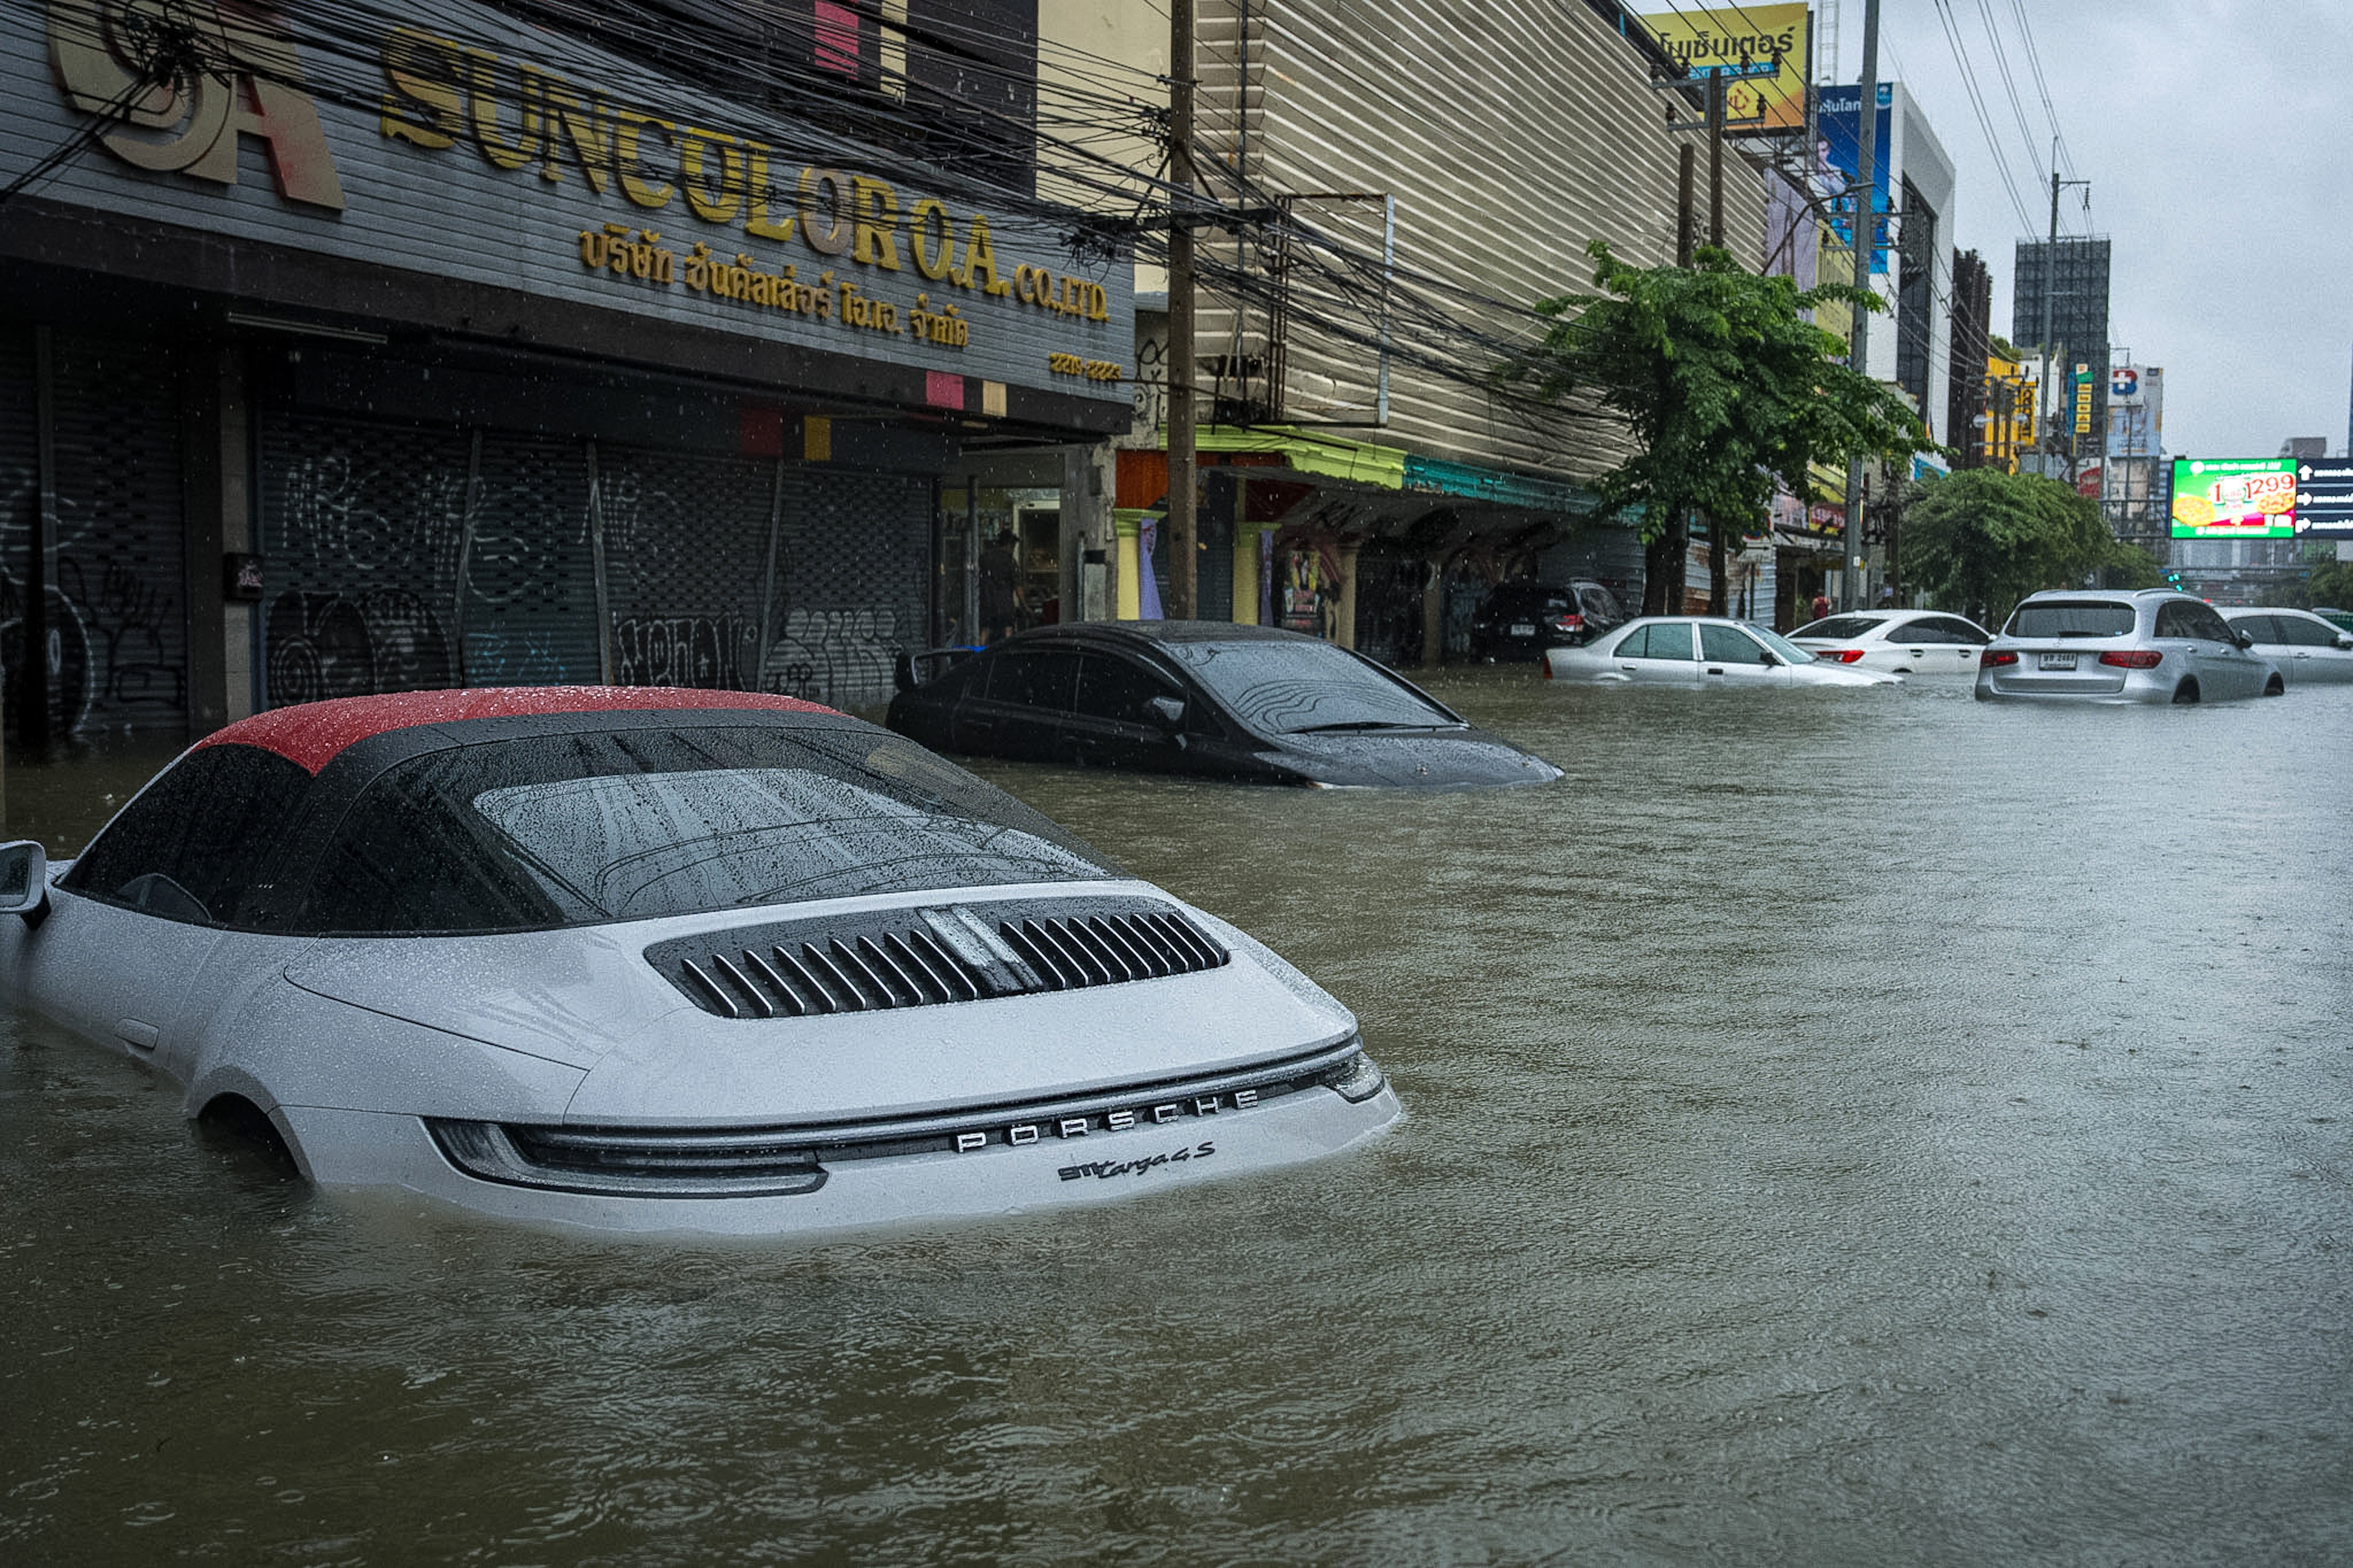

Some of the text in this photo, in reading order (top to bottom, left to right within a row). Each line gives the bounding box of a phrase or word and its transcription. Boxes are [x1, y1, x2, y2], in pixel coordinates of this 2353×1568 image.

[580, 223, 675, 284] บริษัท
[909, 293, 969, 346] จำกัด
[957, 1089, 1259, 1154] PORSCHE
